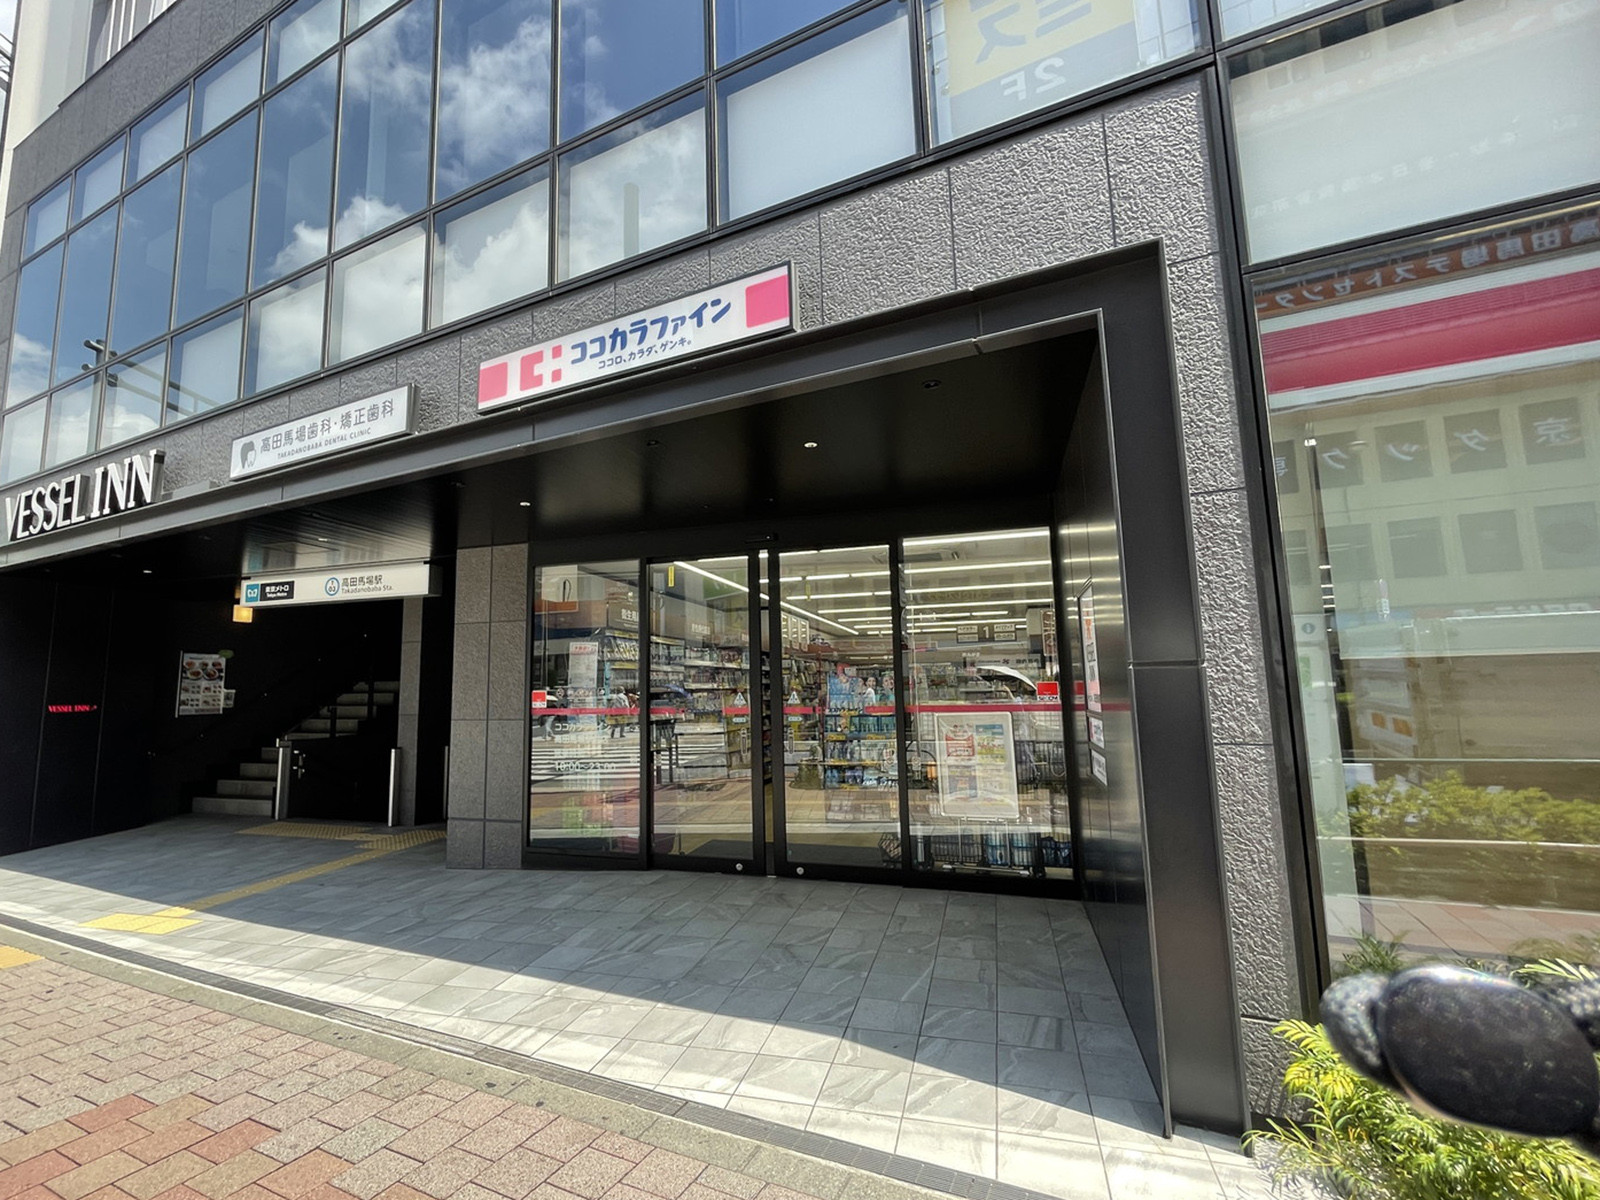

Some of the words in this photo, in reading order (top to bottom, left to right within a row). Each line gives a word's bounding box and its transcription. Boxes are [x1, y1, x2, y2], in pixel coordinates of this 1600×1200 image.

[571, 298, 731, 364] ココカラファイン
[598, 337, 692, 369] ココロ、カラダ、ゲンキ。
[260, 399, 394, 453] 高田馬場歯科・矯正歯科
[277, 441, 323, 459] TAKADANOBABA
[324, 433, 347, 446] DENTAL
[349, 427, 371, 439] CLINIC
[5, 473, 85, 541] VESSEL
[90, 449, 157, 518] INN
[265, 585, 289, 593] 東京メトロ
[342, 575, 382, 587] 高田馬場駅
[342, 586, 382, 594] Takadanobaba
[983, 626, 990, 638] 1
